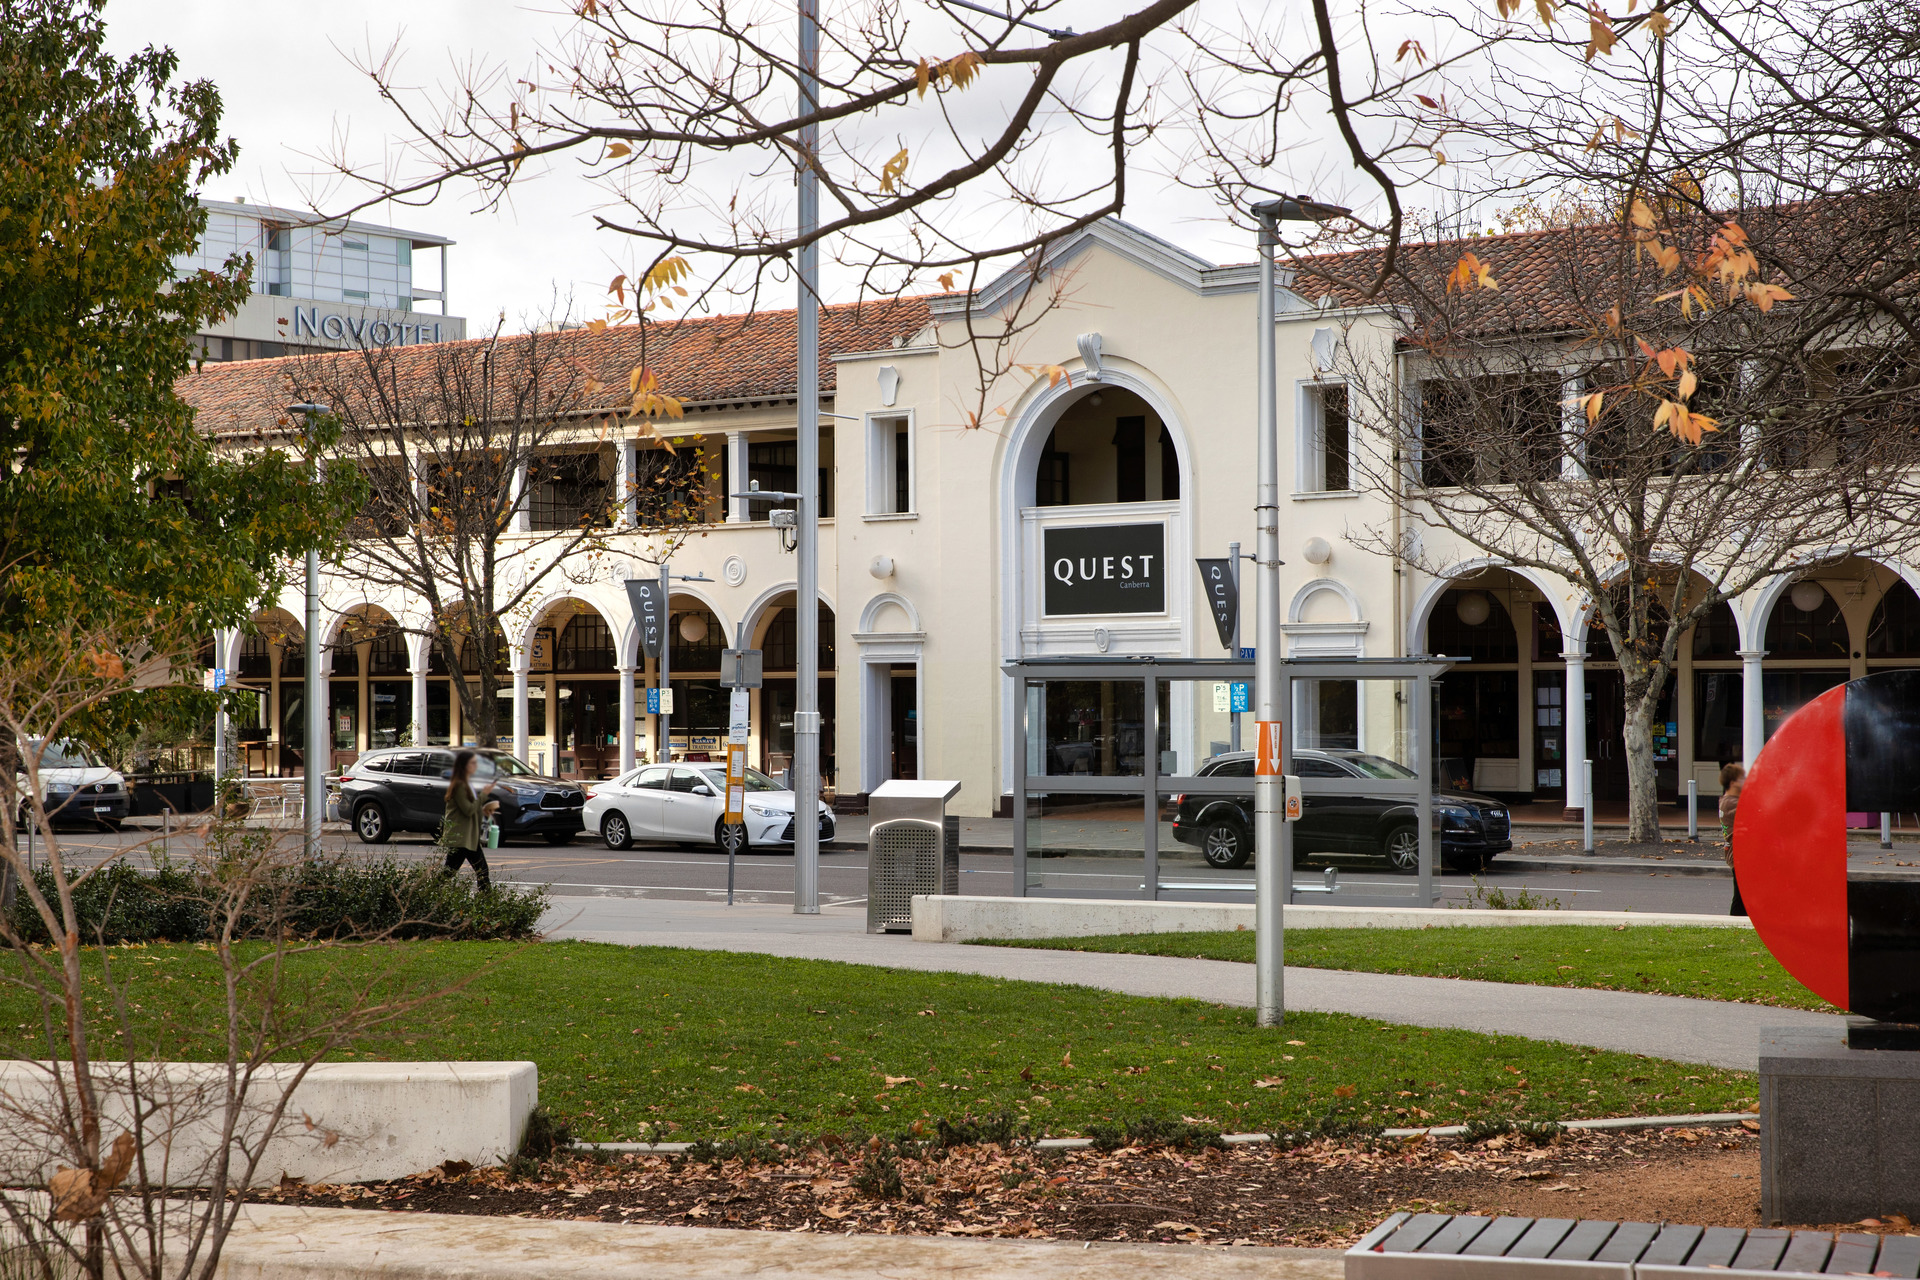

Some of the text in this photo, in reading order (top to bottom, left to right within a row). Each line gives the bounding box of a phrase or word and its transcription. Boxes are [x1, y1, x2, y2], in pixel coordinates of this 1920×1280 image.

[1053, 555, 1154, 586] QUEST
[1119, 581, 1150, 589] Canberra
[639, 585, 657, 646] QUEST
[1211, 565, 1228, 631] QUES
